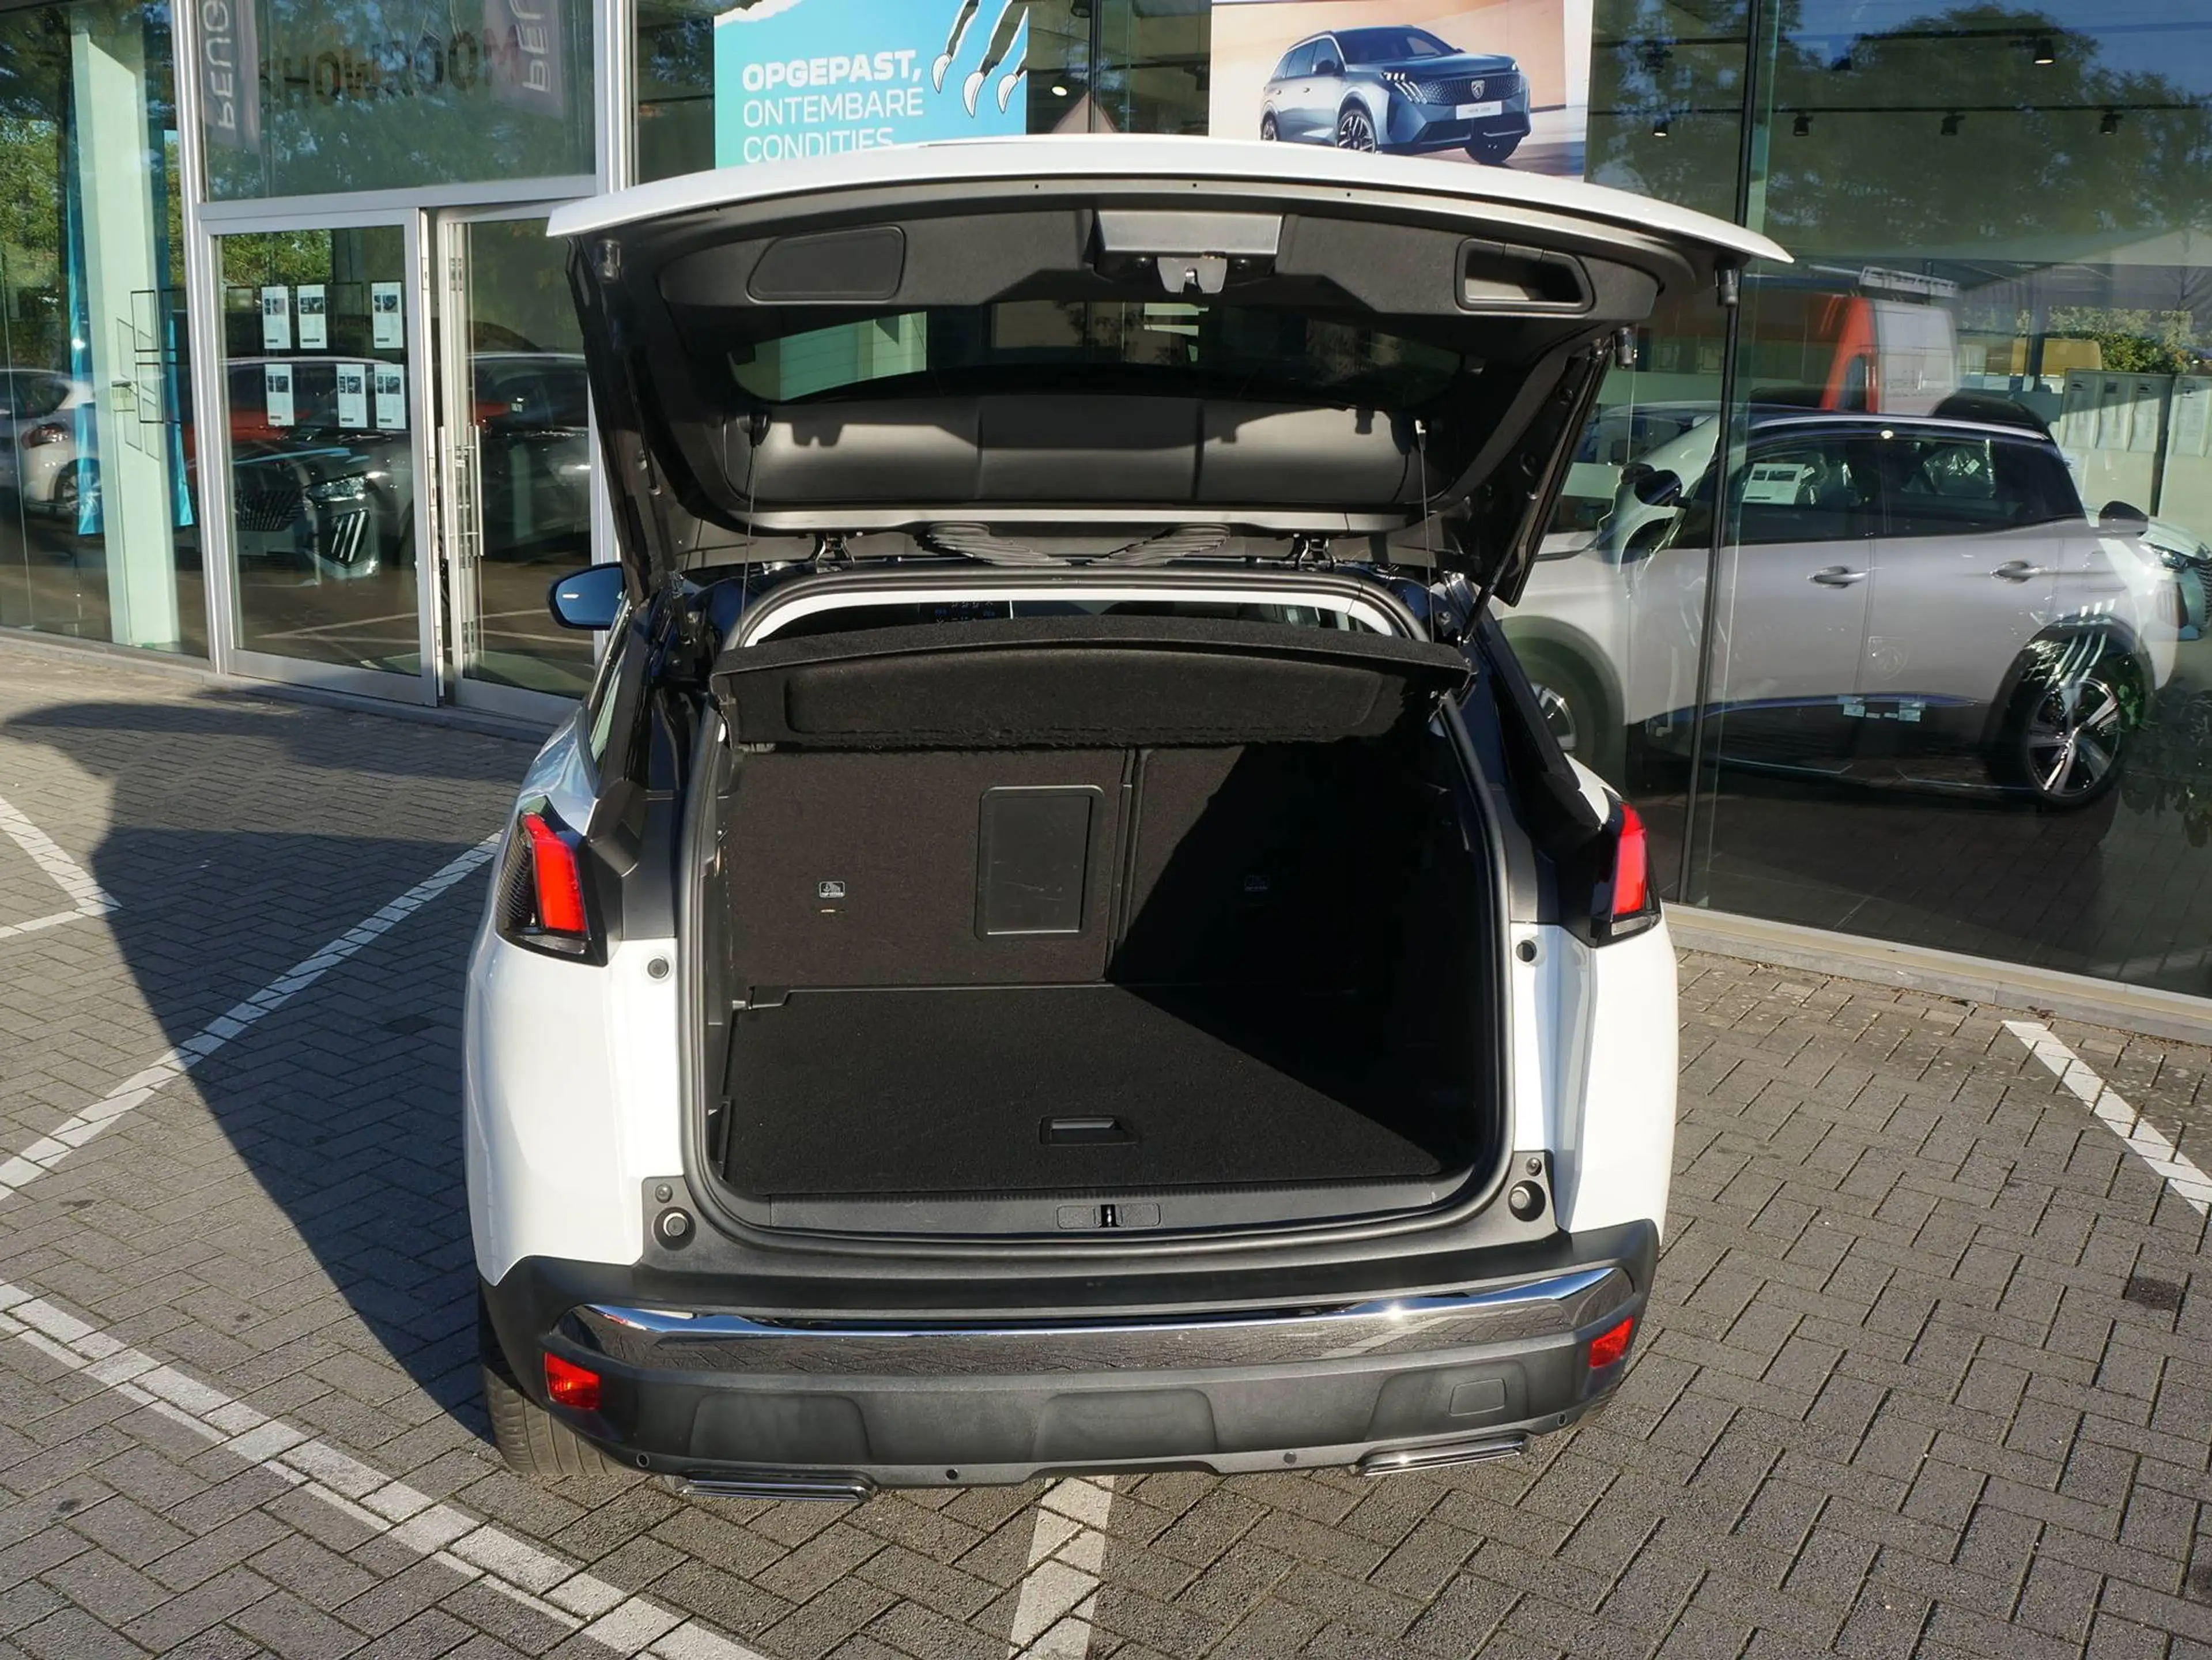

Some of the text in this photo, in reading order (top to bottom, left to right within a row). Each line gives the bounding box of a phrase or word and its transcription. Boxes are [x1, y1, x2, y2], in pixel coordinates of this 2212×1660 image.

[742, 50, 922, 91] OPGEPAST,
[743, 87, 923, 127] ONTEMBARE
[743, 127, 894, 163] CONDITIES
